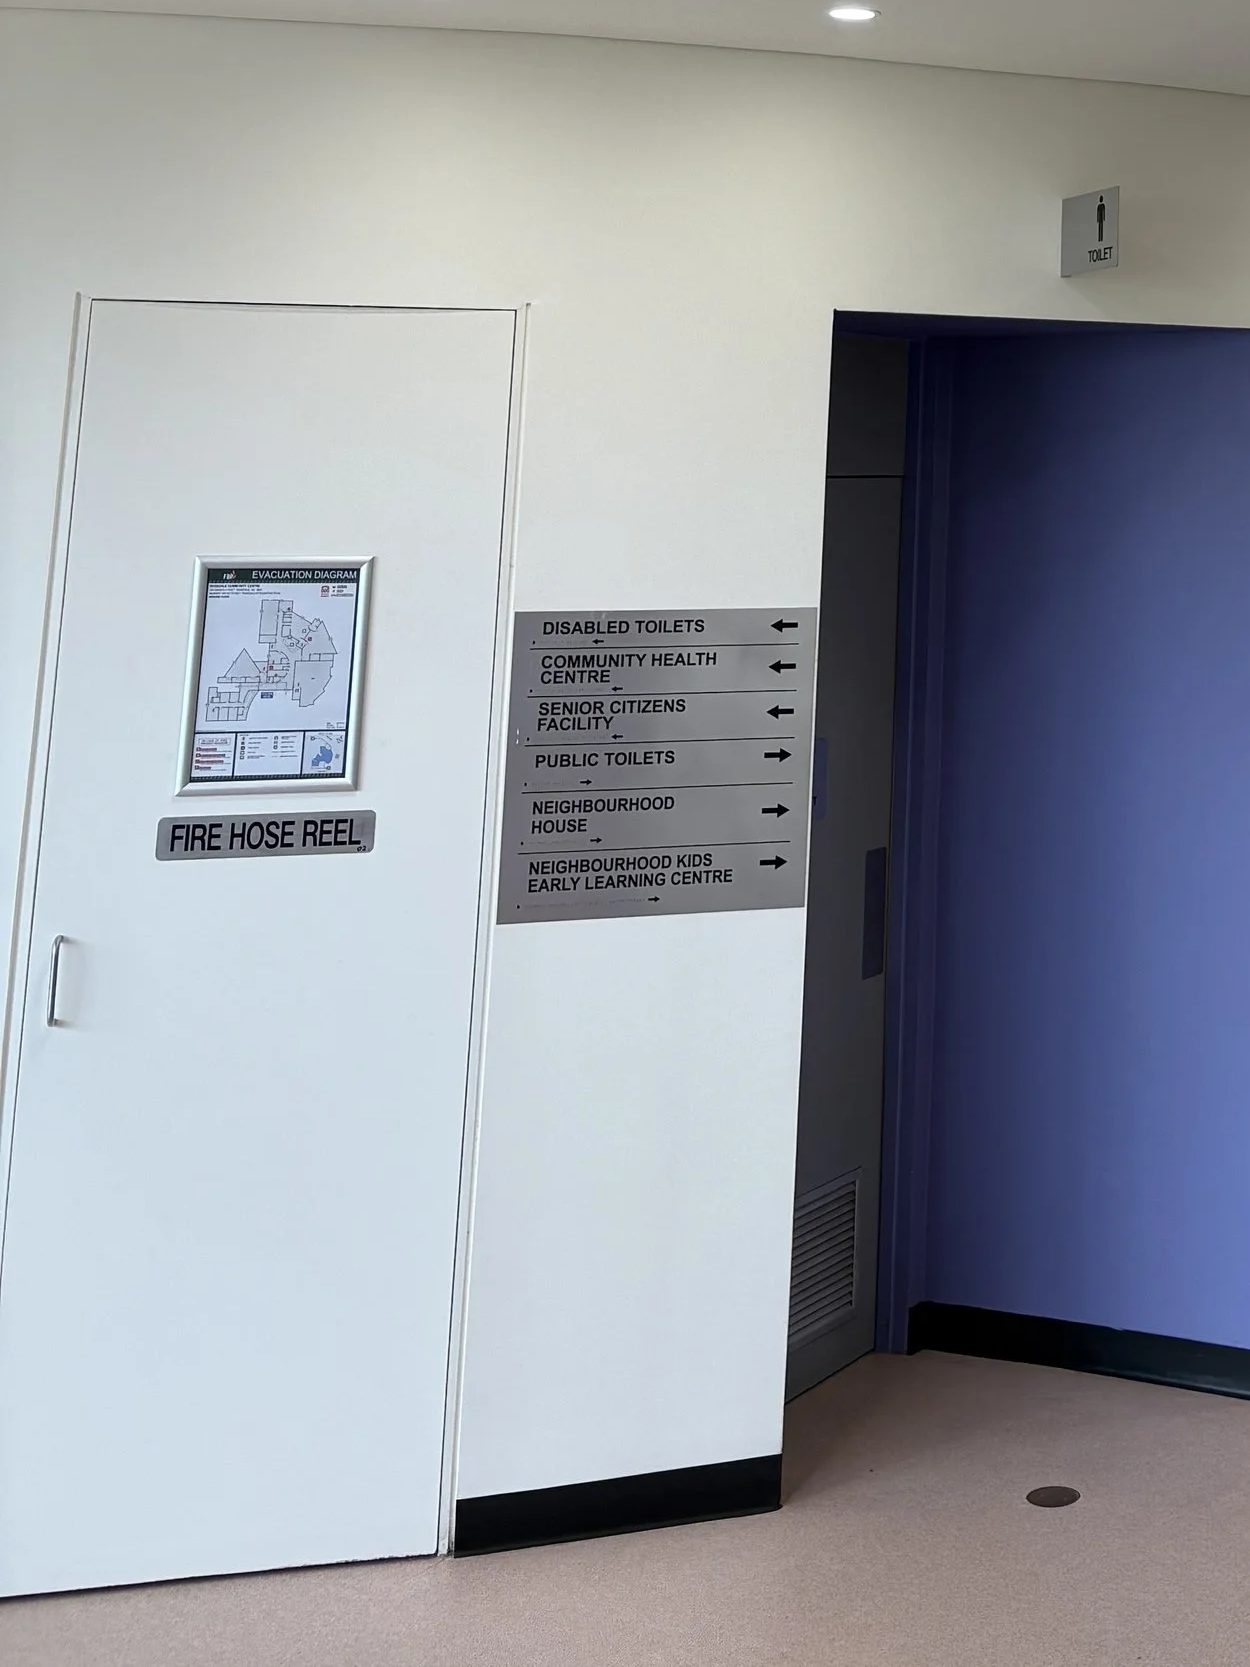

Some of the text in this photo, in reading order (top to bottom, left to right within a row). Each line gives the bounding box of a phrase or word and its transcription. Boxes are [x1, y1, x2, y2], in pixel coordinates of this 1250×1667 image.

[1088, 246, 1113, 263] TOILET
[251, 569, 358, 580] EVACUATION DIAGRAM
[542, 618, 706, 636] DISABLED TOILETS
[540, 651, 718, 670] COMMUNITY HEALTH
[539, 668, 611, 685] CENTRE
[538, 698, 687, 717] SENIOR CITIZENS
[536, 715, 615, 733] FACILITY
[534, 750, 676, 769] PUBLIC TOILETS
[531, 795, 676, 816] NEIGHBOURHOOD
[169, 818, 362, 852] FIRE HOSE REEL
[530, 818, 588, 835] HOUSE
[528, 852, 714, 876] NEIGHBOURHOOD KIDS
[527, 868, 734, 894] EARLY LEARNING CENTRE
